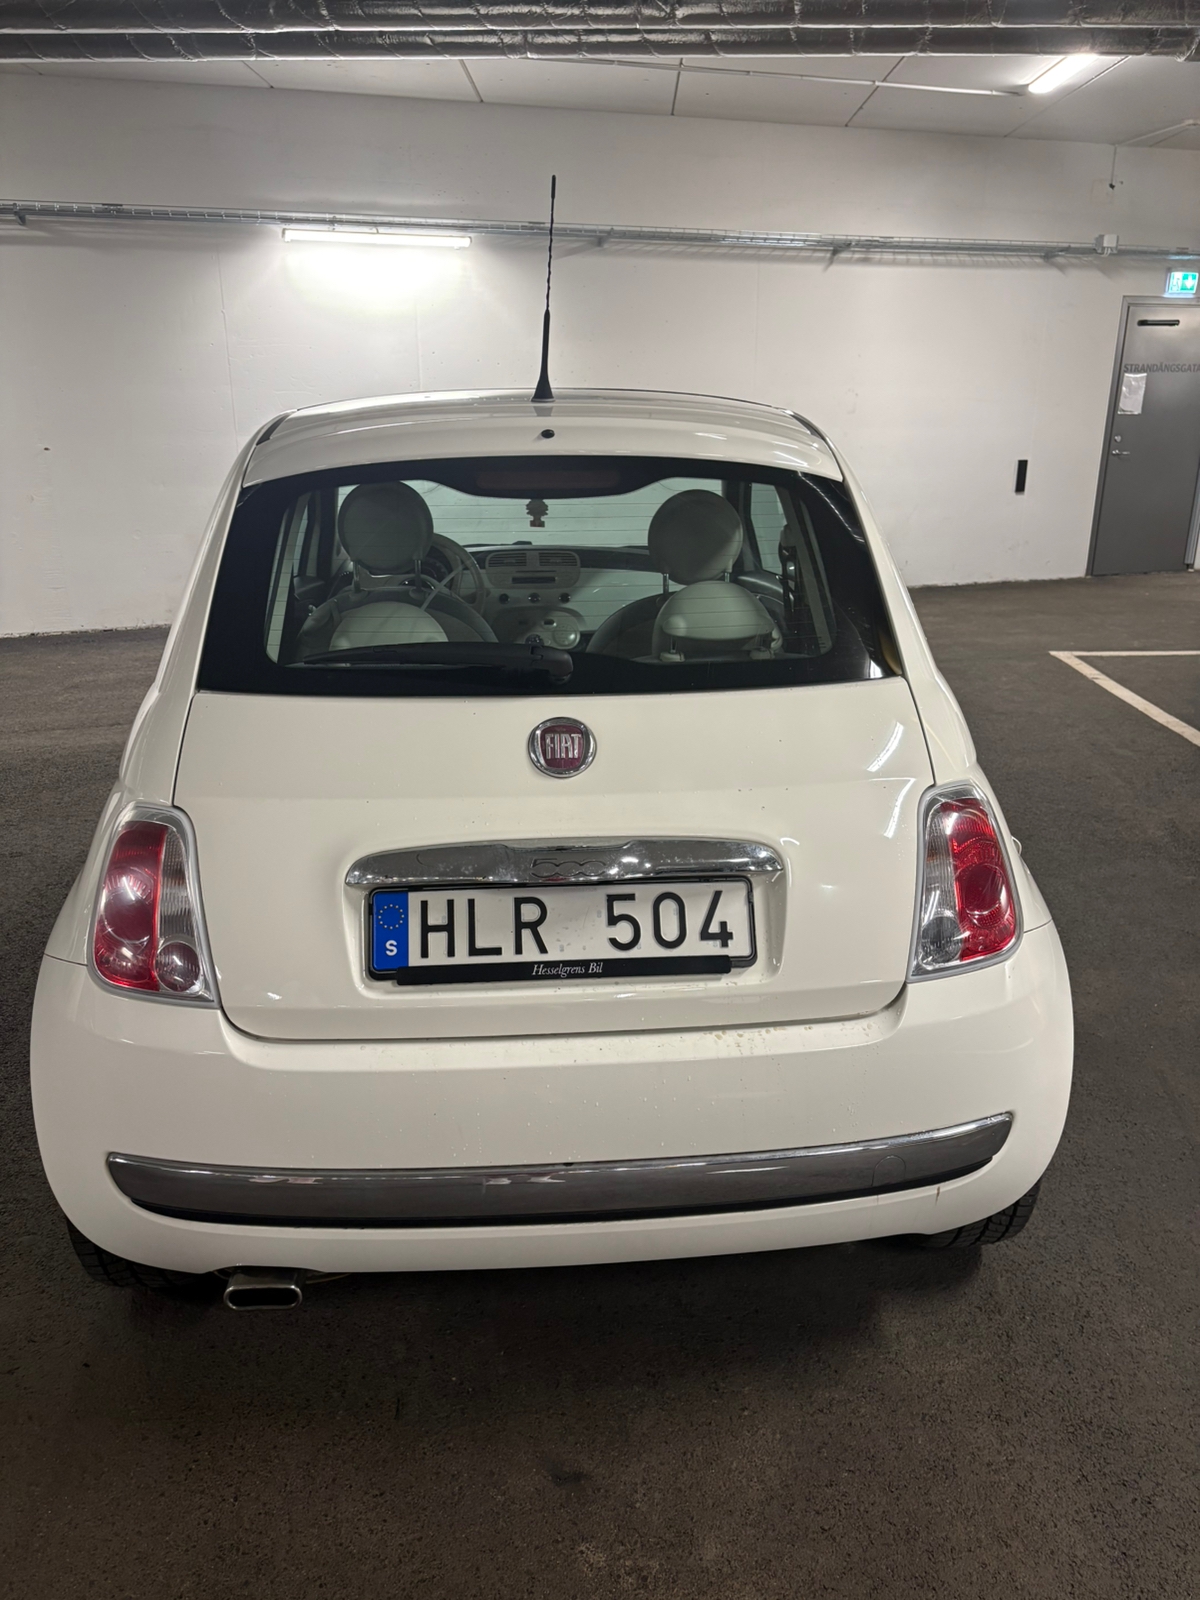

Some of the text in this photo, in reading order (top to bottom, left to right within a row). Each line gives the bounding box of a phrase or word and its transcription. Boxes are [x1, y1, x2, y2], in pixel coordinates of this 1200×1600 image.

[544, 733, 582, 760] FIAT
[530, 857, 606, 879] 500
[420, 890, 734, 959] HLR 504
[385, 939, 398, 956] S
[531, 962, 604, 978] Hesselgrens Bil
